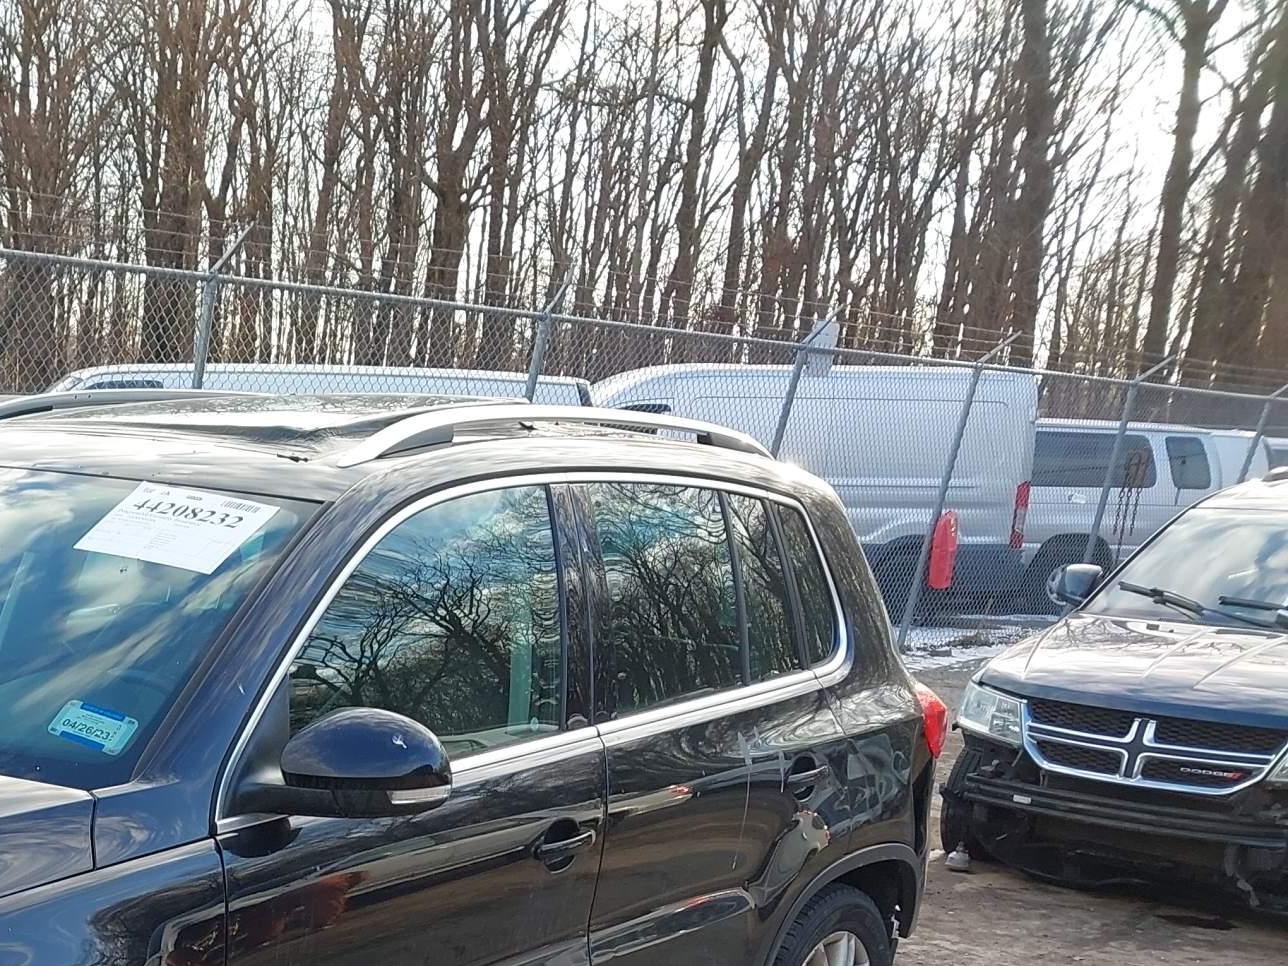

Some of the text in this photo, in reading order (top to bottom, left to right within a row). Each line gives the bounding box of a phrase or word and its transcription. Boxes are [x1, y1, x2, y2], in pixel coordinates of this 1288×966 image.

[133, 499, 244, 528] 44208232
[62, 718, 111, 741] 04/26/23
[1179, 766, 1233, 778] DODGE
